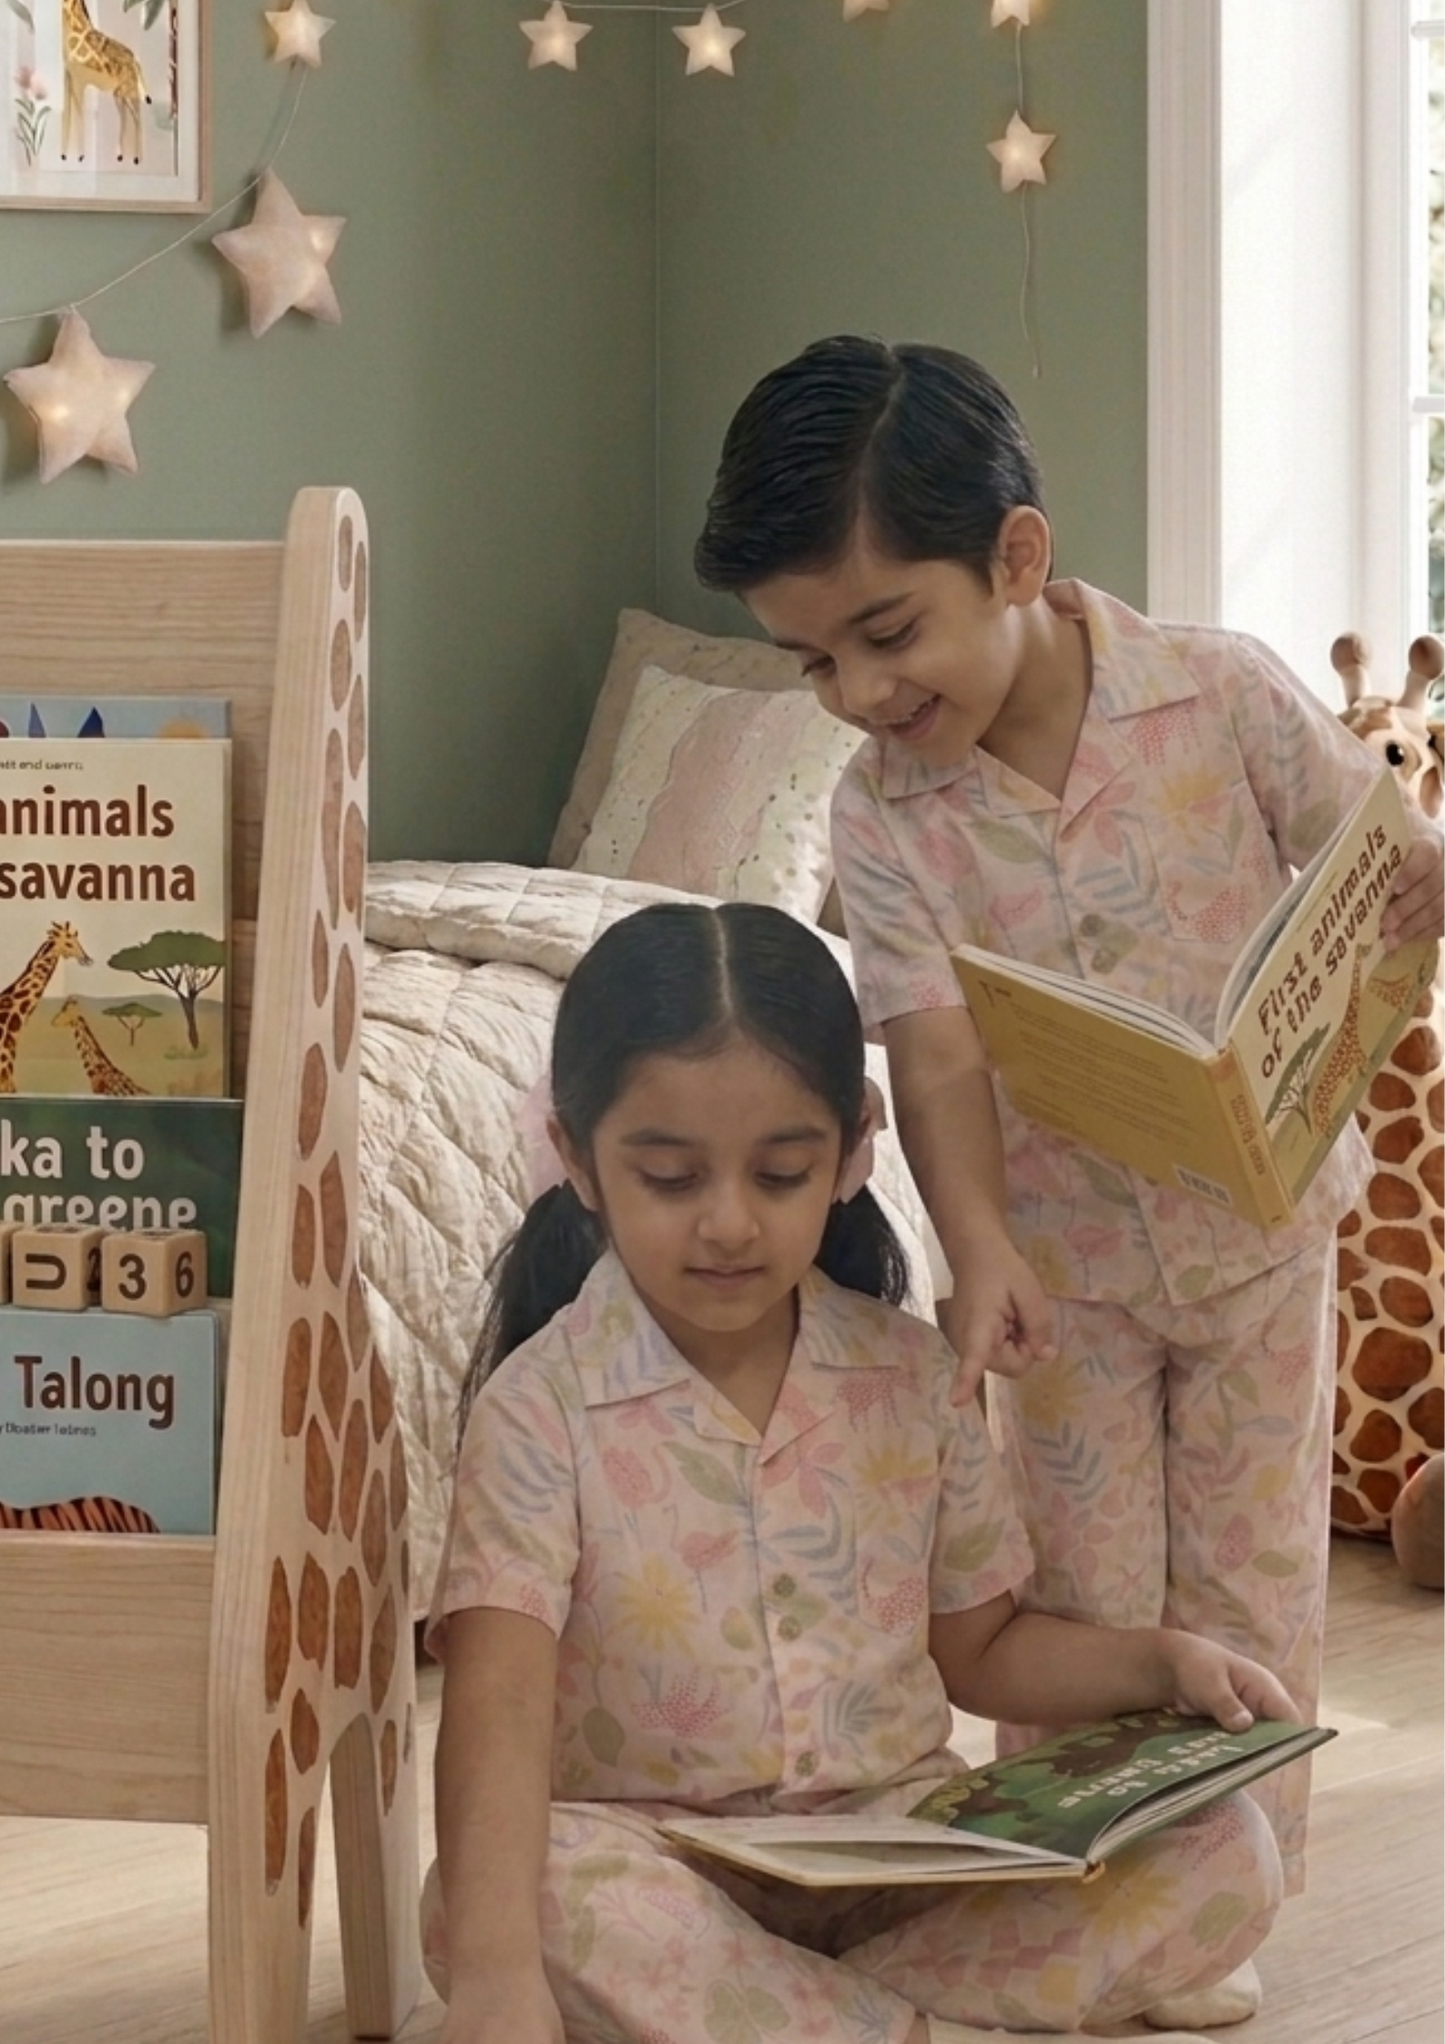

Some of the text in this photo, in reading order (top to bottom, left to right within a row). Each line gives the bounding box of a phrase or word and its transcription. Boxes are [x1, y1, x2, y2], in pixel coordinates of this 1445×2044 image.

[0, 784, 174, 837] nimals
[0, 861, 195, 901] savanna
[1258, 951, 1308, 1036] First
[1310, 824, 1386, 956] animals
[1261, 1027, 1282, 1078] of
[1286, 975, 1322, 1033] the
[1326, 844, 1401, 976] savanna
[1, 1119, 144, 1180] ka to
[118, 1253, 147, 1300] 3
[175, 1251, 194, 1298] 6
[14, 1355, 174, 1430] Talong
